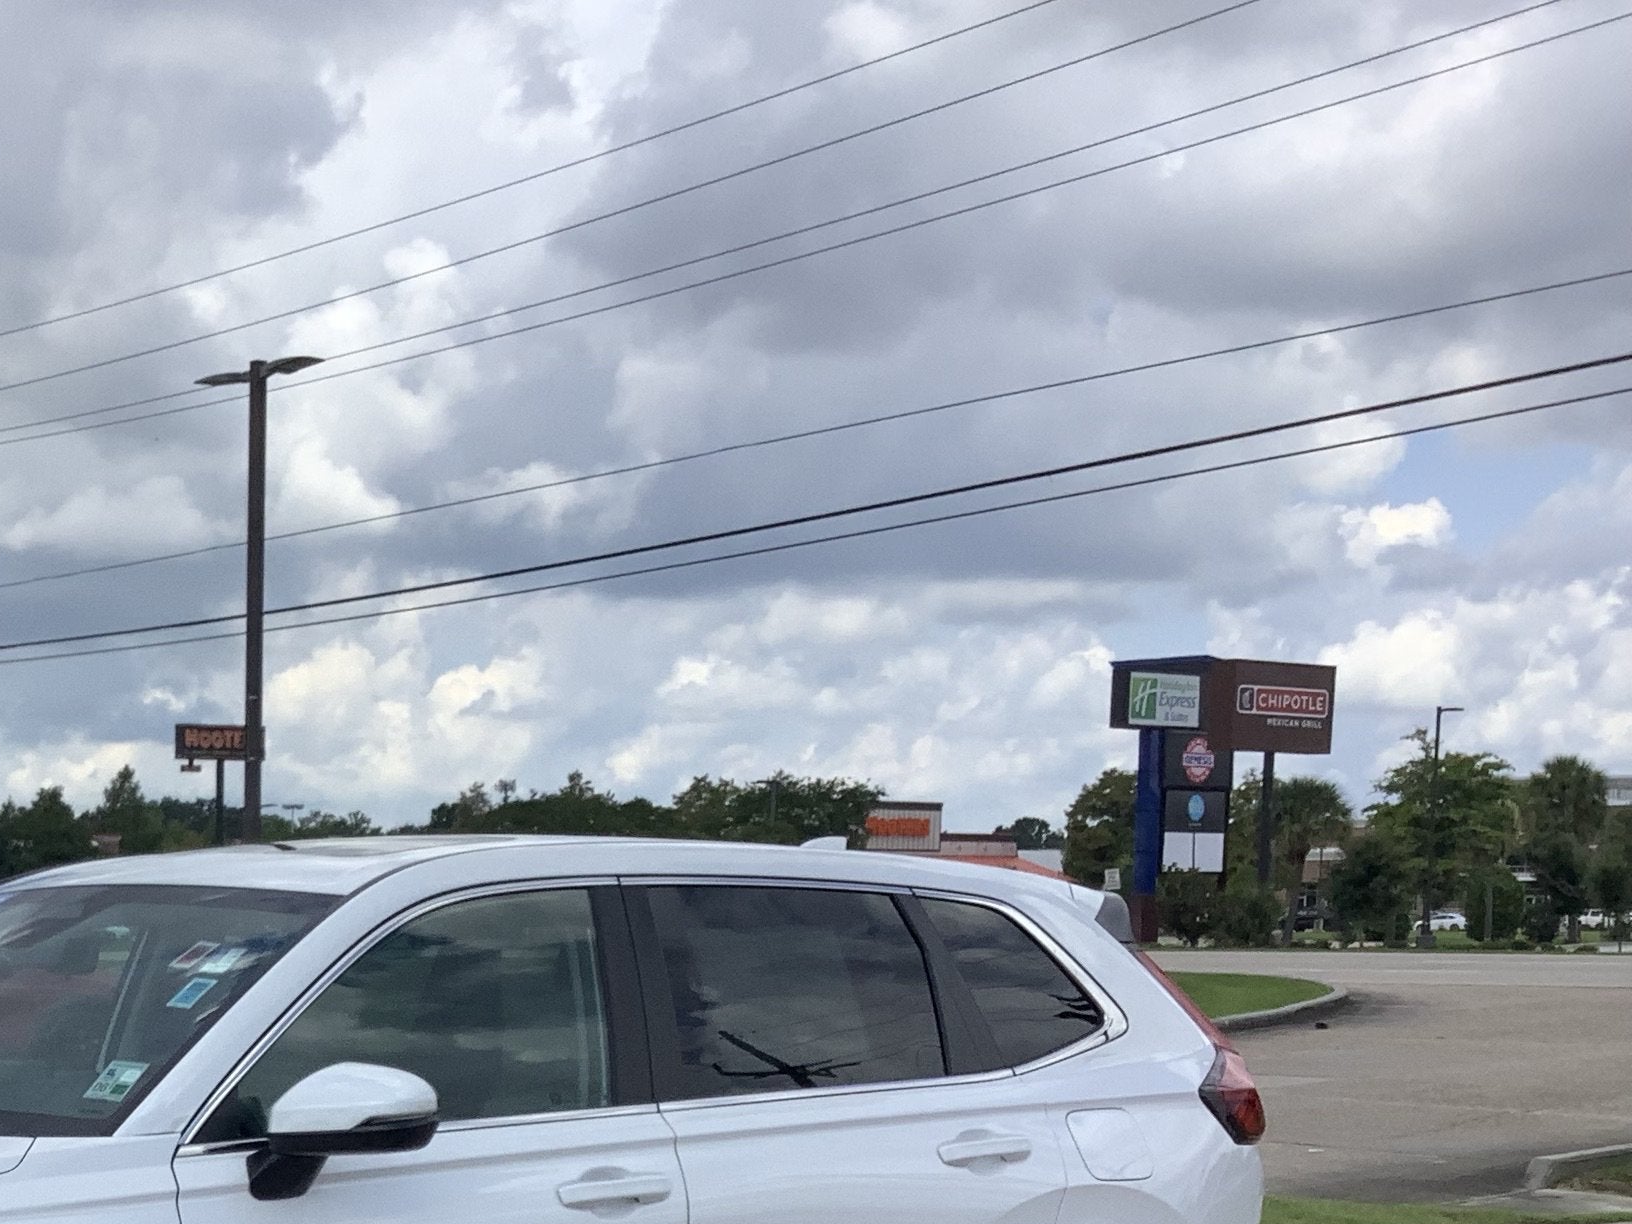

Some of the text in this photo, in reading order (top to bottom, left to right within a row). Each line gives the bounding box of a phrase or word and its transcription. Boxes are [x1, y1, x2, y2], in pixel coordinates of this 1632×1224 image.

[1159, 692, 1197, 711] Express
[1258, 693, 1324, 711] CHIPOTLE
[1267, 718, 1323, 729] MEXICAN GRILL
[184, 728, 242, 749] HOOTE
